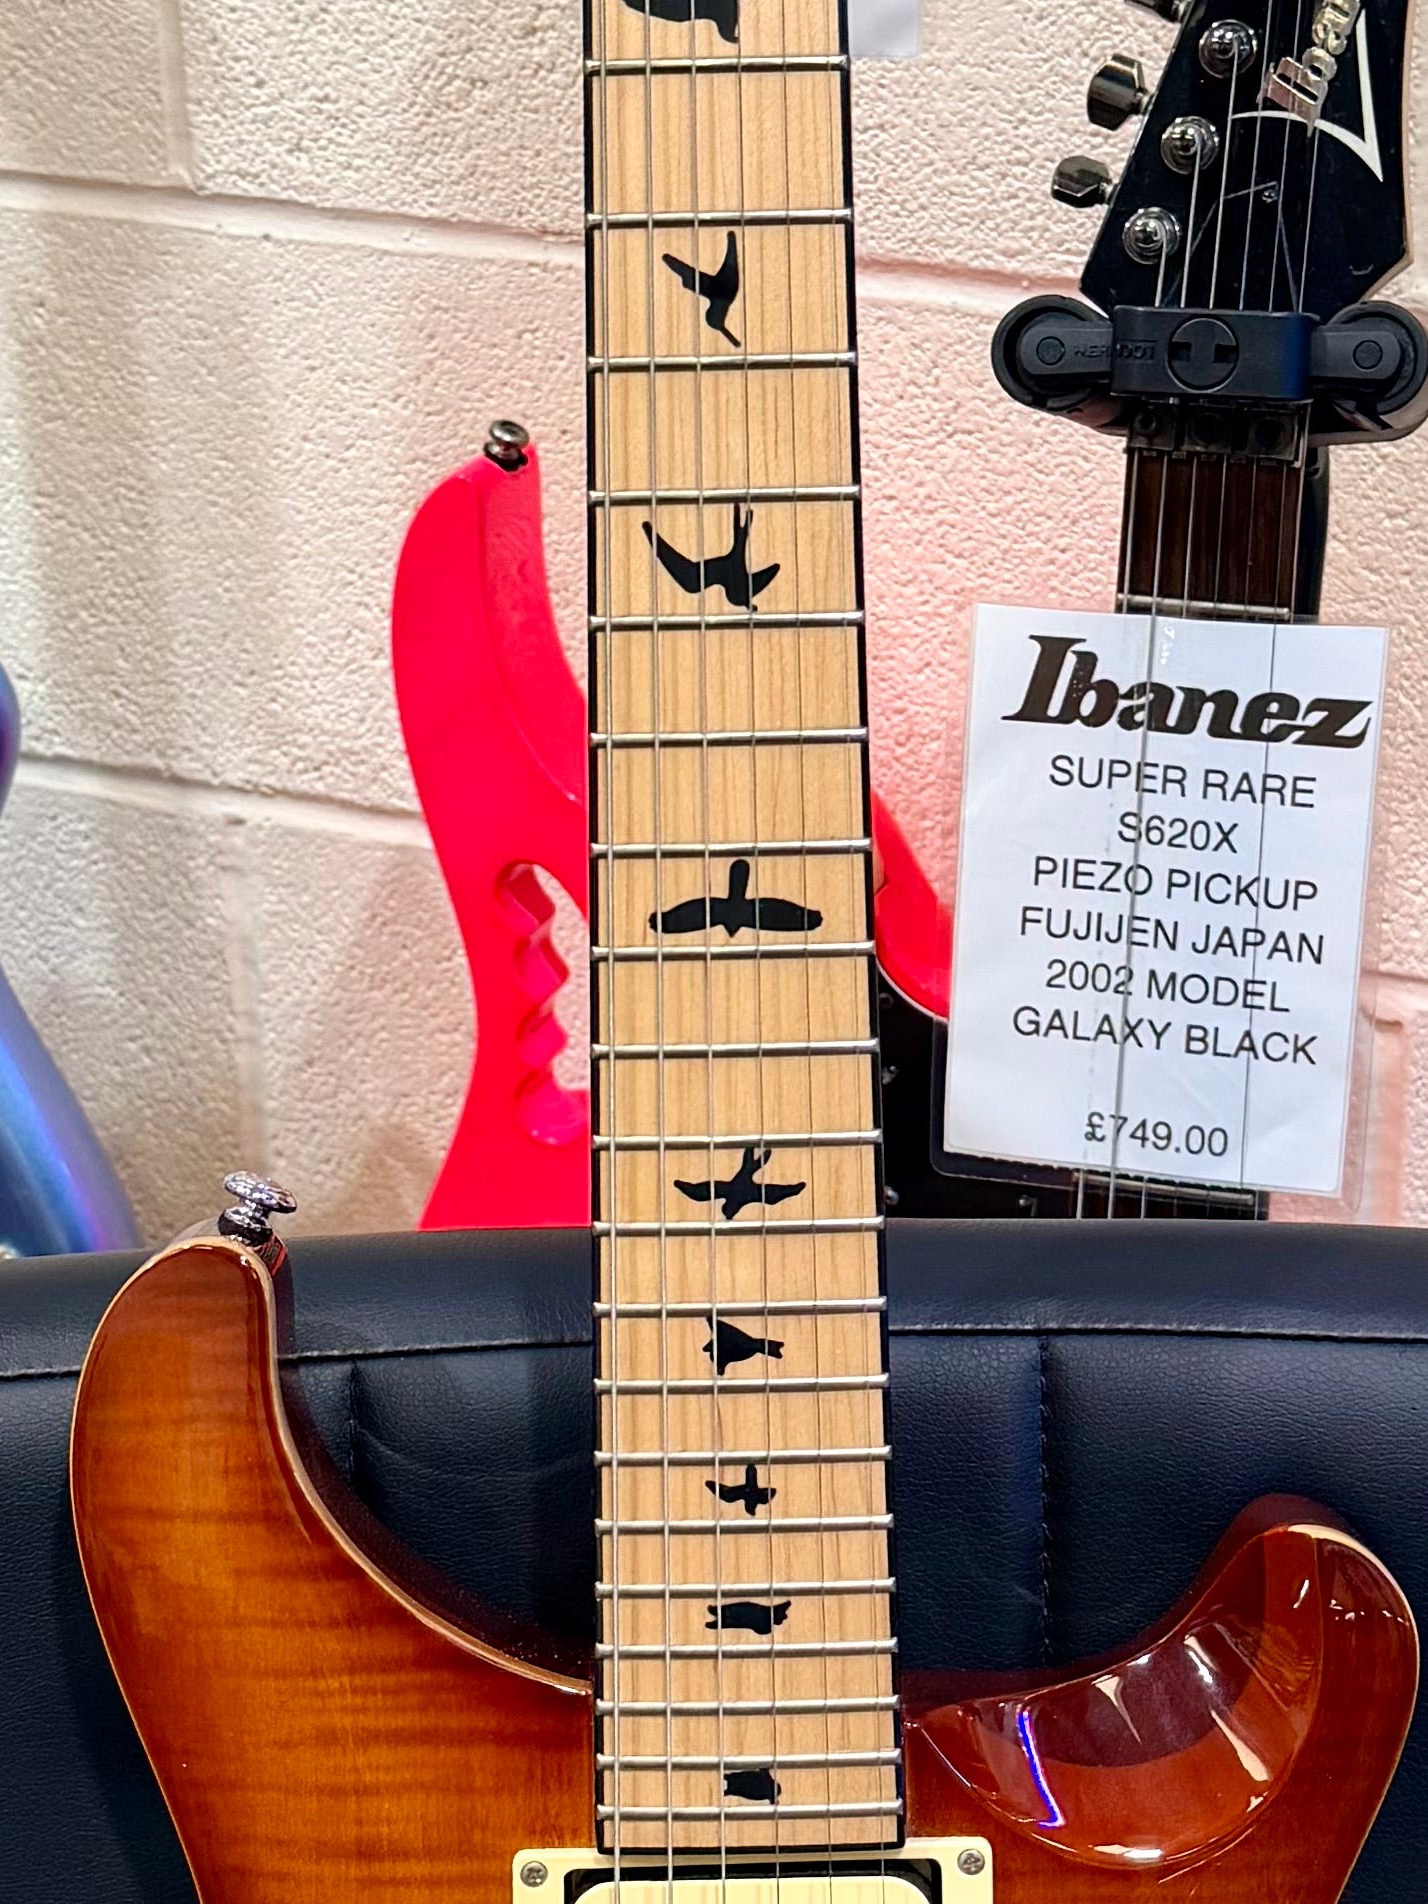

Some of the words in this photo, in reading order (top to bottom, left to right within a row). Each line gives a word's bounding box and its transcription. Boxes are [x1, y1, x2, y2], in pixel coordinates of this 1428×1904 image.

[1002, 634, 1373, 749] Ibanez
[1050, 755, 1187, 798] SUPER
[1203, 770, 1317, 809] RARE
[1118, 812, 1238, 853] S620X
[1034, 857, 1153, 897] PIEZO
[1167, 870, 1318, 911] PICKUP
[1020, 907, 1178, 951] FUJIJEN
[1191, 927, 1324, 965] JAPAN
[1045, 960, 1133, 995] 2002
[1147, 970, 1289, 1013] MODEL
[1013, 1007, 1172, 1048] GALAXY
[1185, 1024, 1317, 1065] BLACK
[1084, 1112, 1228, 1156] £749.00
